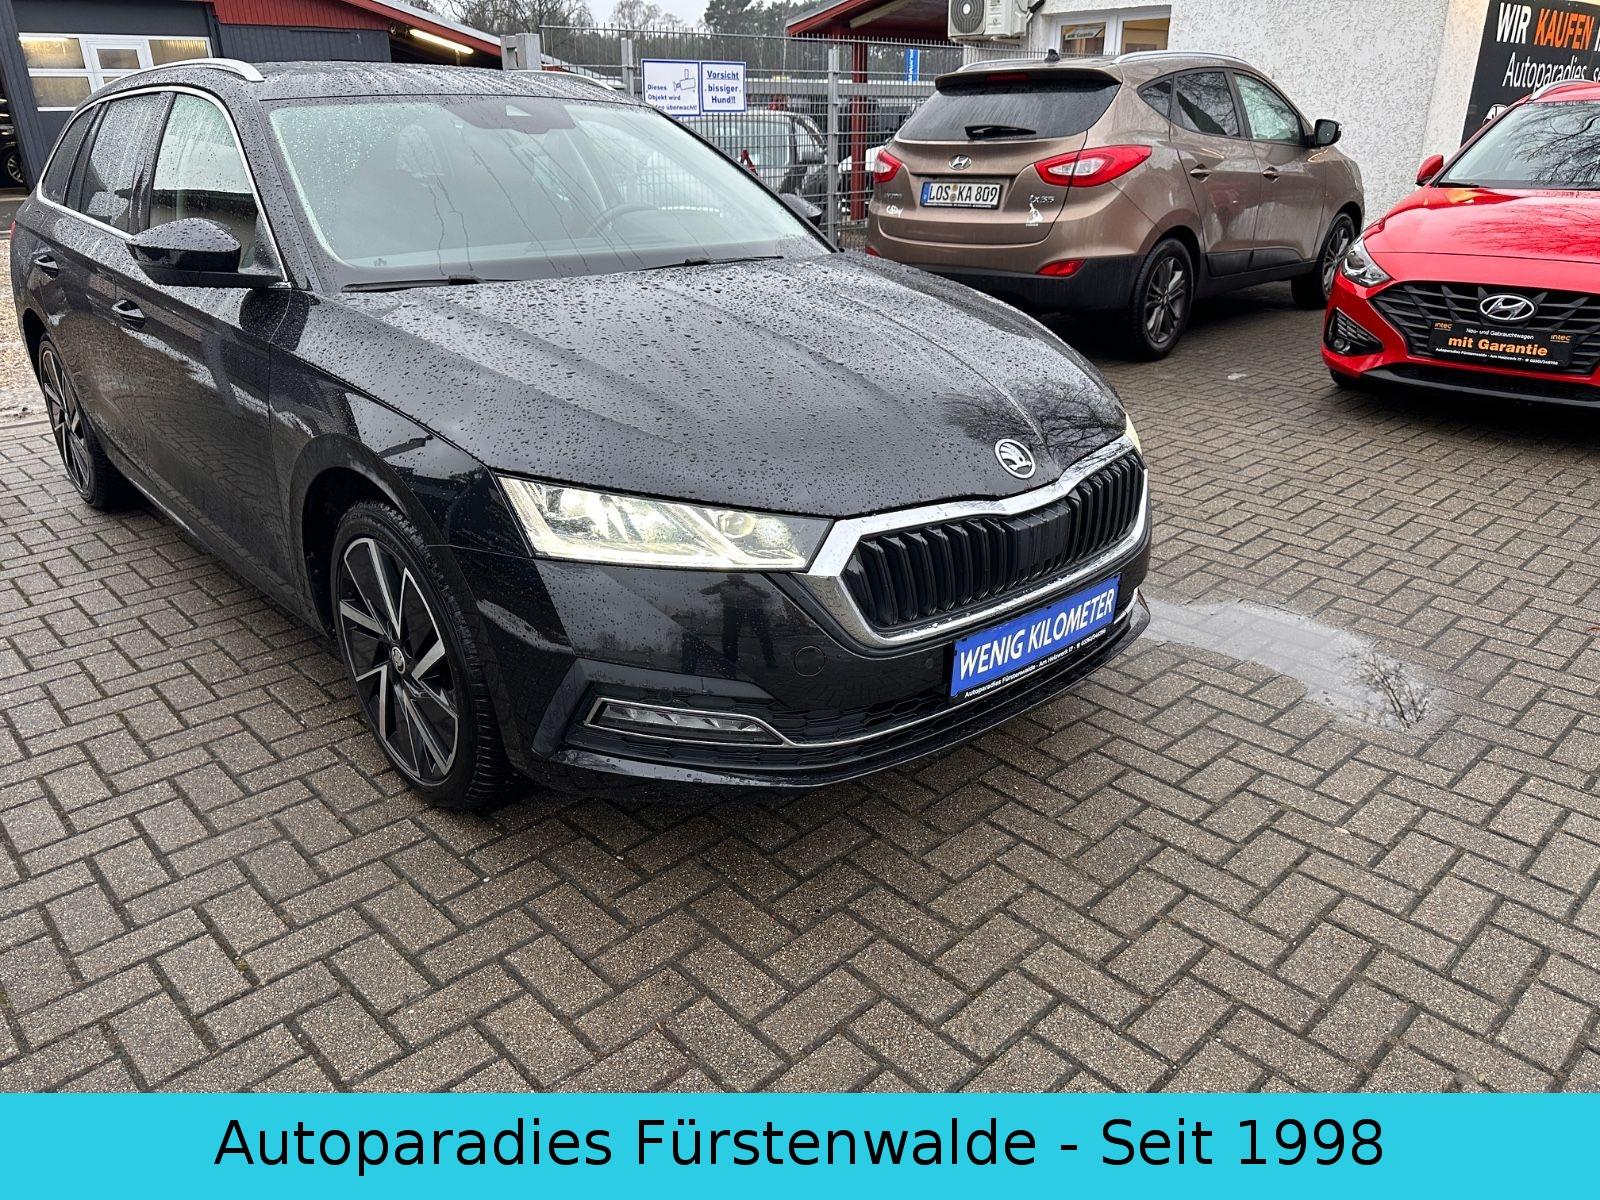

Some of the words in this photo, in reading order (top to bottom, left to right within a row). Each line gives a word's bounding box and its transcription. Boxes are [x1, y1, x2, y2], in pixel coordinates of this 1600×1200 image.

[1496, 2, 1532, 45] WIR
[1534, 8, 1595, 51] KAUFEN
[707, 70, 740, 80] Vorsicht
[1502, 52, 1587, 93] Autoparadies
[647, 94, 667, 102] Objekt
[708, 85, 738, 94] bissiger
[929, 185, 950, 201] LOS
[957, 185, 972, 202] KA
[975, 186, 998, 203] 809
[1448, 336, 1474, 348] mit
[1478, 338, 1548, 356] Garantie
[960, 628, 1026, 681] WENIG
[1027, 588, 1115, 653] KILOMETER
[964, 679, 1002, 699] Autoparadies
